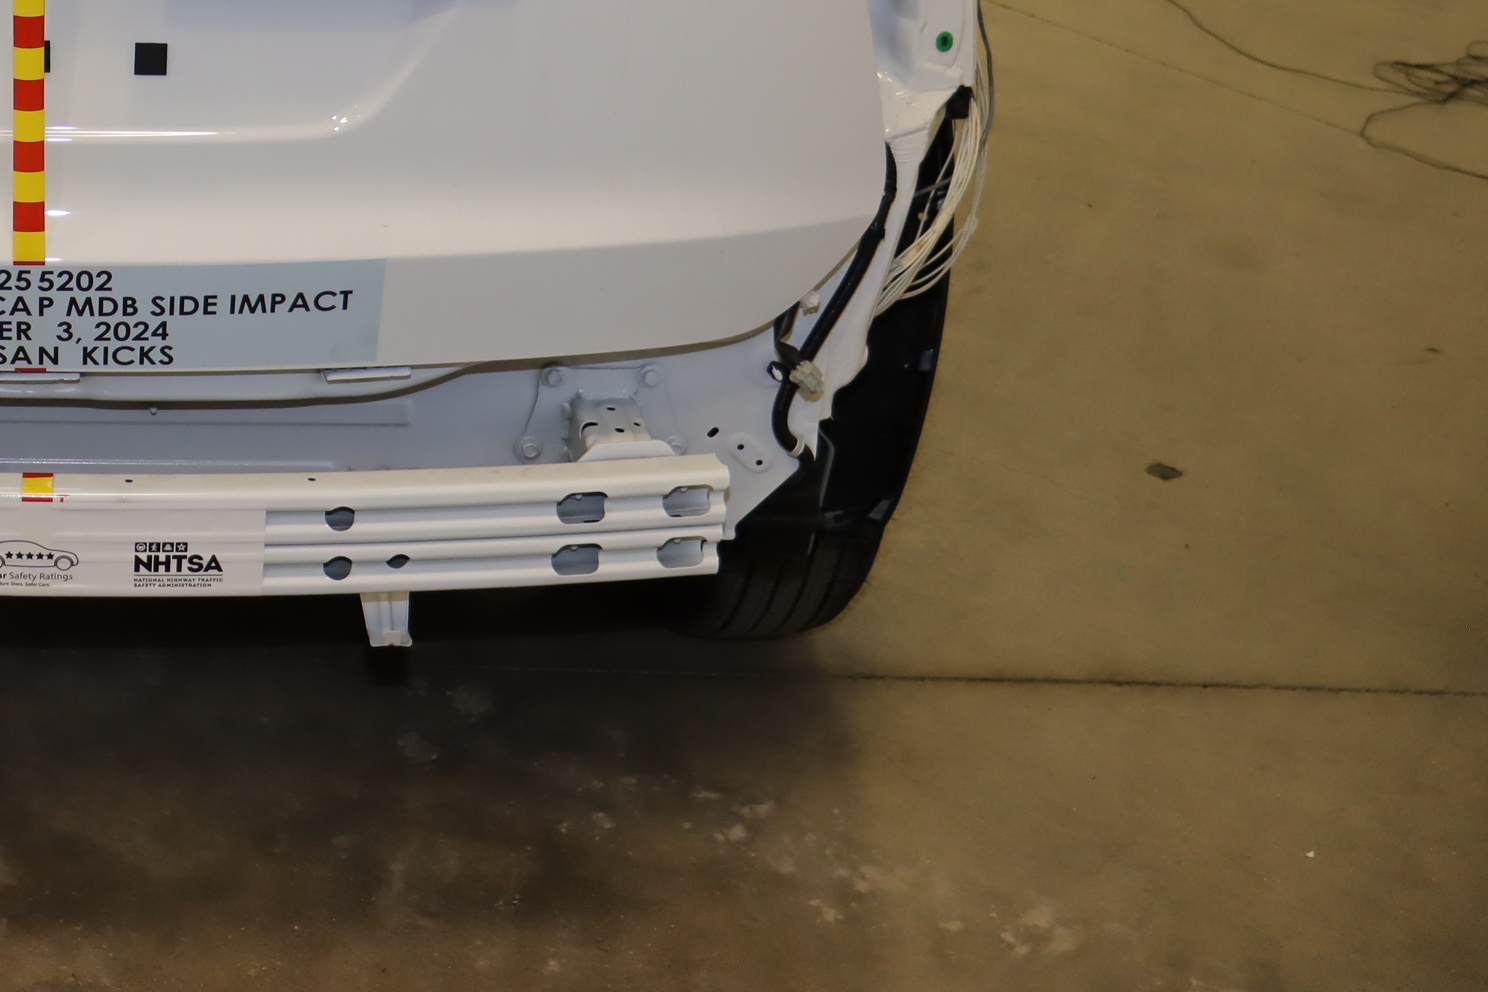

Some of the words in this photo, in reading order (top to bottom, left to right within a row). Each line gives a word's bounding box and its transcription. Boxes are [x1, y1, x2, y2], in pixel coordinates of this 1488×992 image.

[65, 296, 139, 317] MDB
[150, 294, 218, 316] SIDE
[229, 289, 354, 315] IMPACT
[55, 321, 83, 345] 3,
[93, 320, 169, 342] 2024
[81, 345, 175, 366] KICKS
[134, 554, 223, 573] NHTSA
[8, 572, 37, 581] Safety
[39, 572, 73, 582] Ratings
